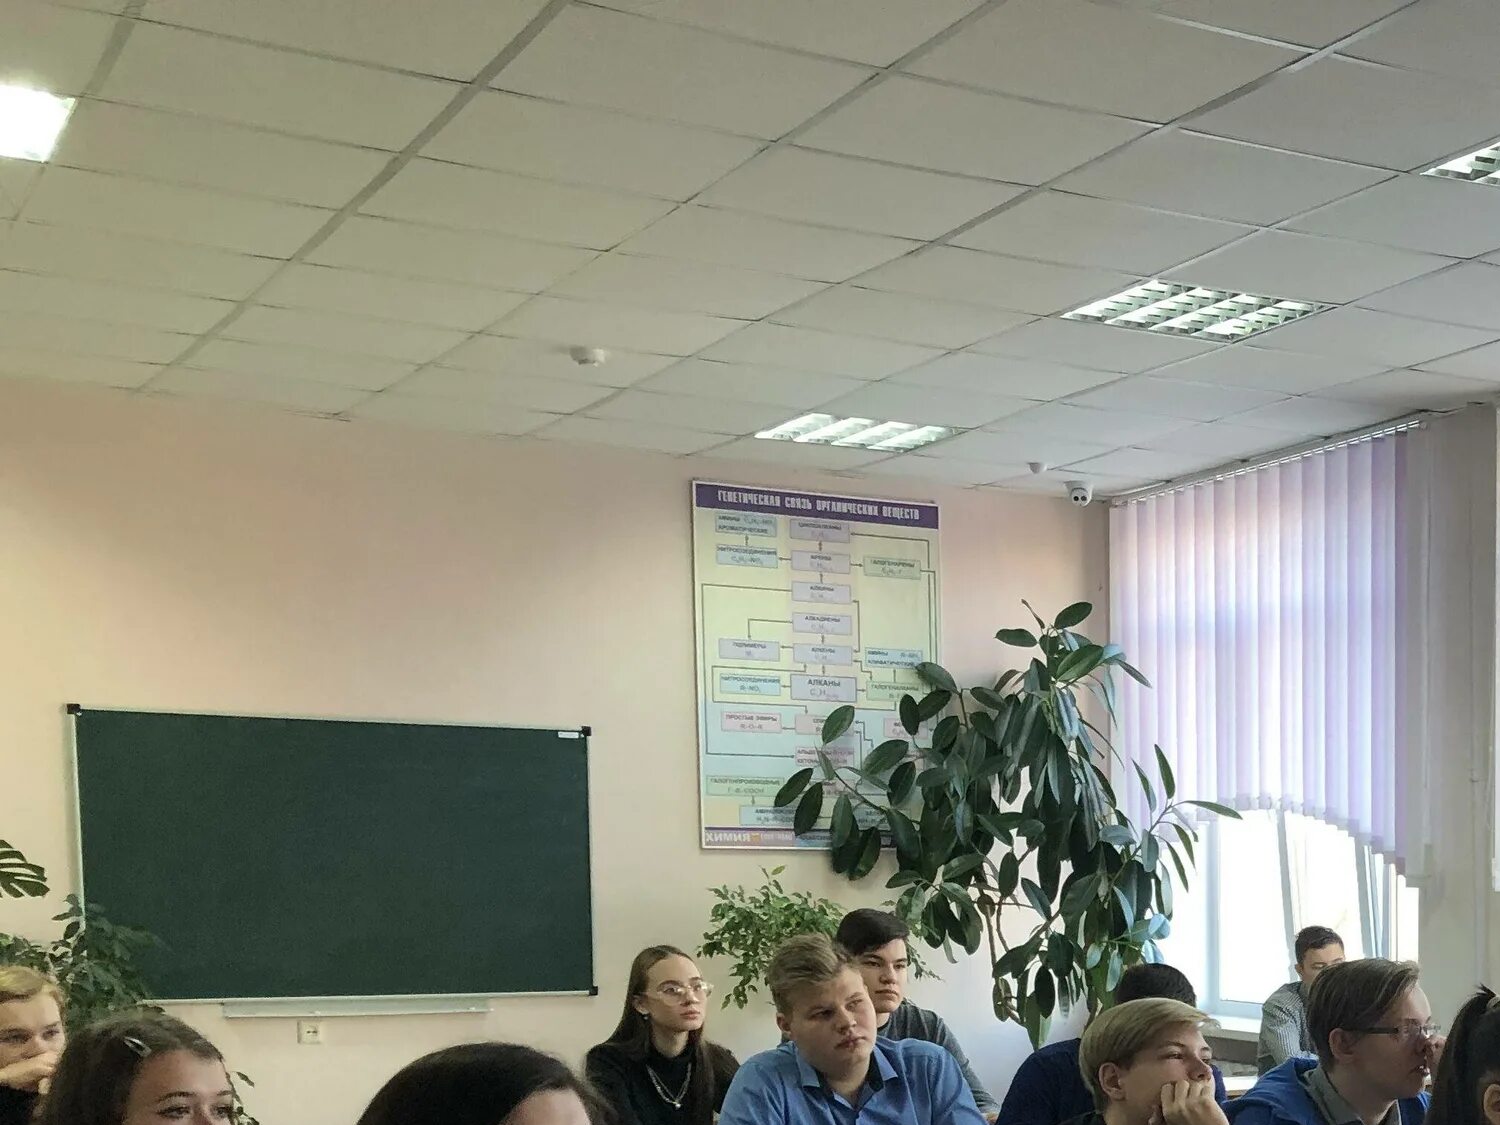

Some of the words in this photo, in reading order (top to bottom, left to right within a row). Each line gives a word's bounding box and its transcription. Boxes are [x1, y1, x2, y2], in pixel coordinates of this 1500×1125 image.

[717, 489, 781, 507] ГЕНЕТИЧЕСКАЯ
[784, 496, 812, 510] СВЯЗЬ
[816, 499, 879, 516] ОРГАНИЧЕСКИХ
[882, 505, 920, 520] ВЕЩЕСТВ
[807, 679, 841, 688] АЛКАНЫ
[705, 832, 751, 843] ХИМИЯ
